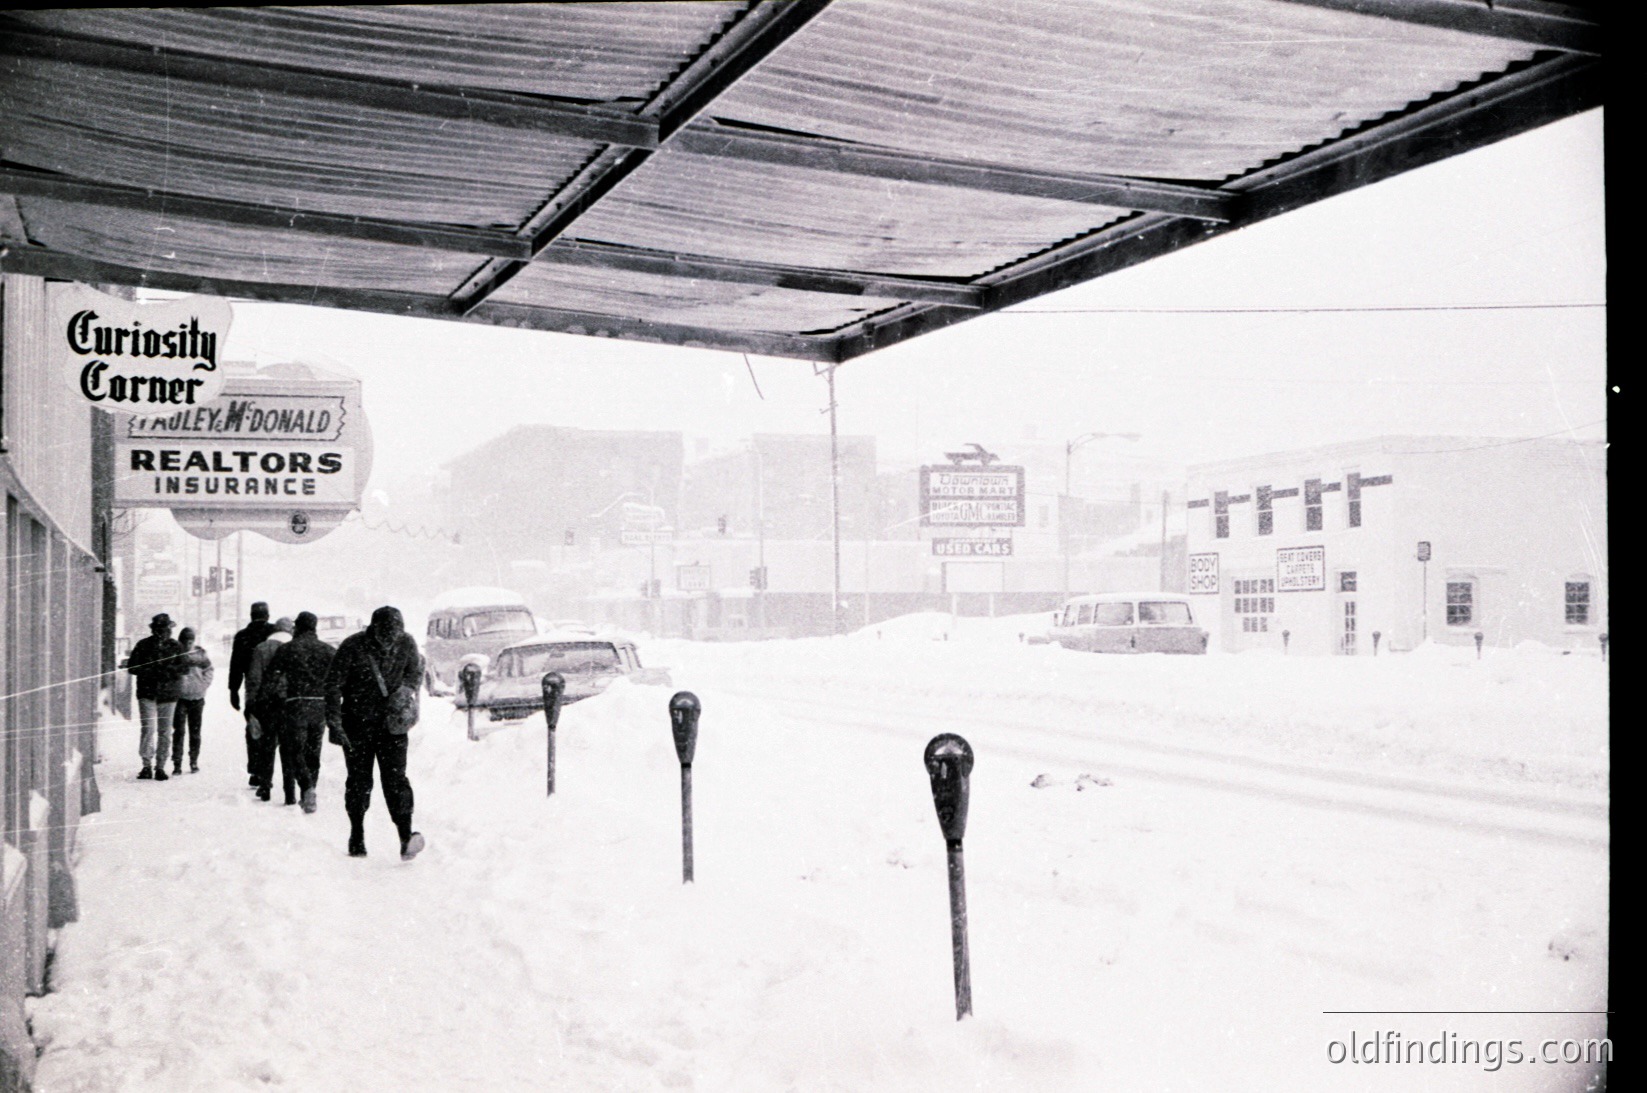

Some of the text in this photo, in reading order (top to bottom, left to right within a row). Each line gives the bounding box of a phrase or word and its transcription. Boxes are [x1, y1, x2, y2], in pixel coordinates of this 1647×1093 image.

[67, 309, 217, 371] Curiosity
[80, 359, 204, 405] Corner
[130, 449, 343, 474] REALTORS
[154, 476, 316, 495] INSURANCE
[932, 487, 1014, 495] MOTOR MART
[936, 542, 1010, 555] USED CARS
[1190, 557, 1217, 573] BODY
[1190, 575, 1217, 590] SHOP
